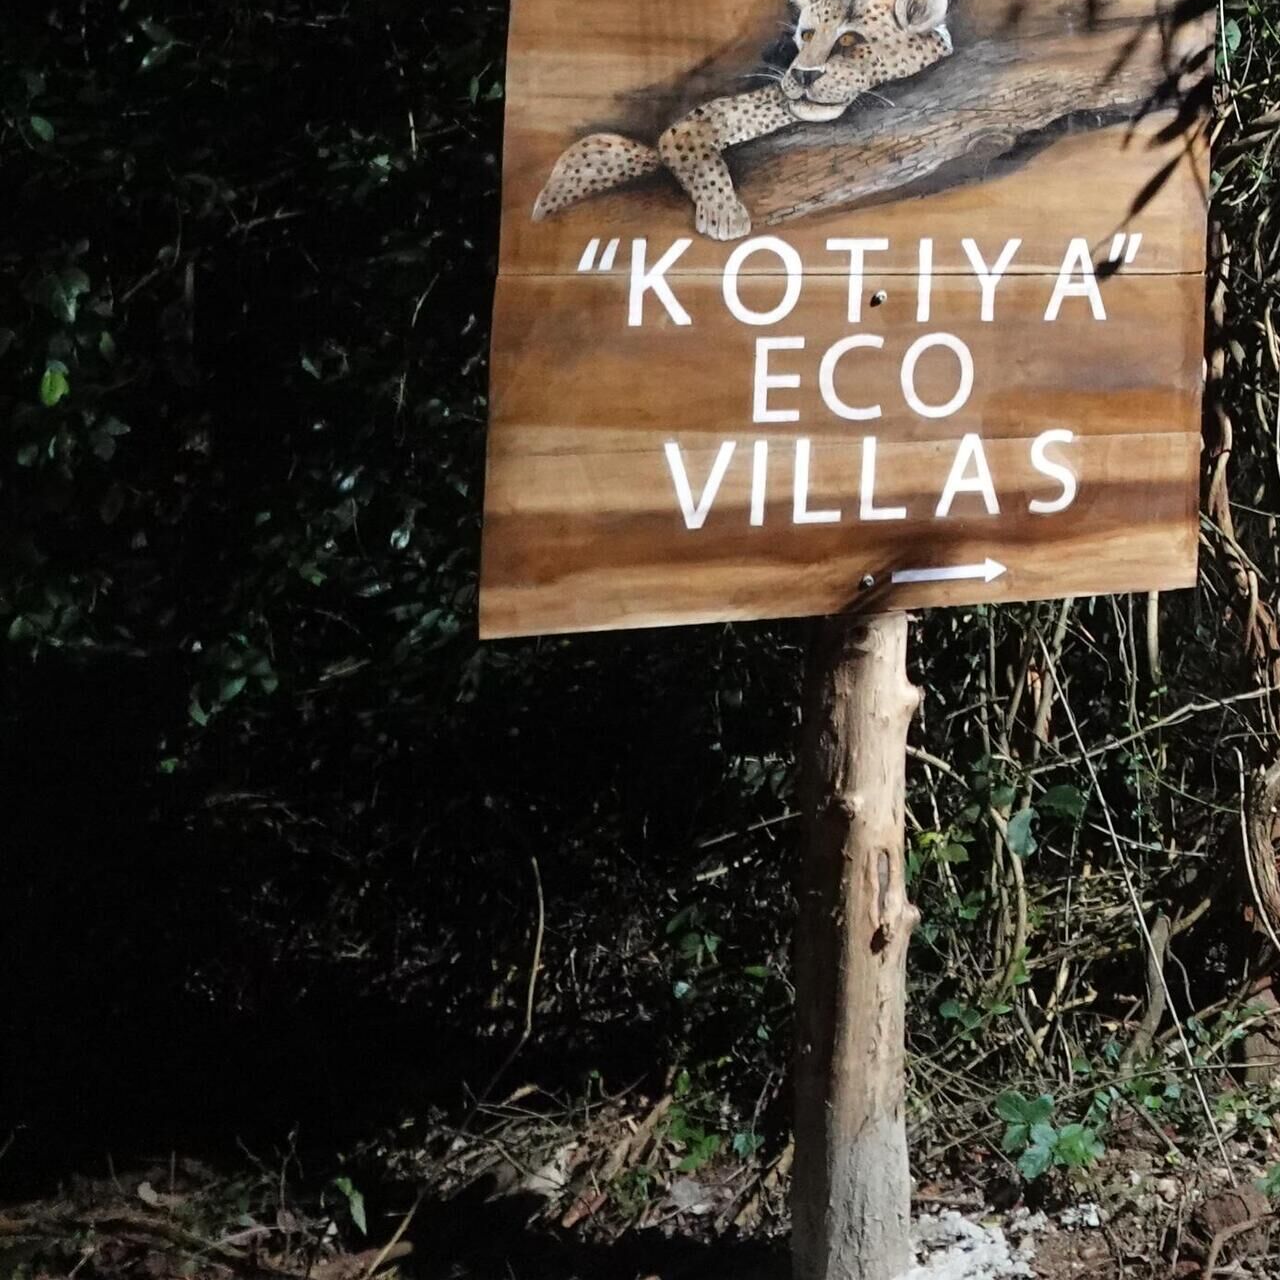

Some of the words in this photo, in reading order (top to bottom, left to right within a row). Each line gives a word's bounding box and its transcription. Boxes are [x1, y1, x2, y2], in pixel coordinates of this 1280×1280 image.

[577, 234, 1143, 327] “KOTIYA”
[752, 332, 975, 423] ECO
[664, 429, 1079, 530] VILLAS
